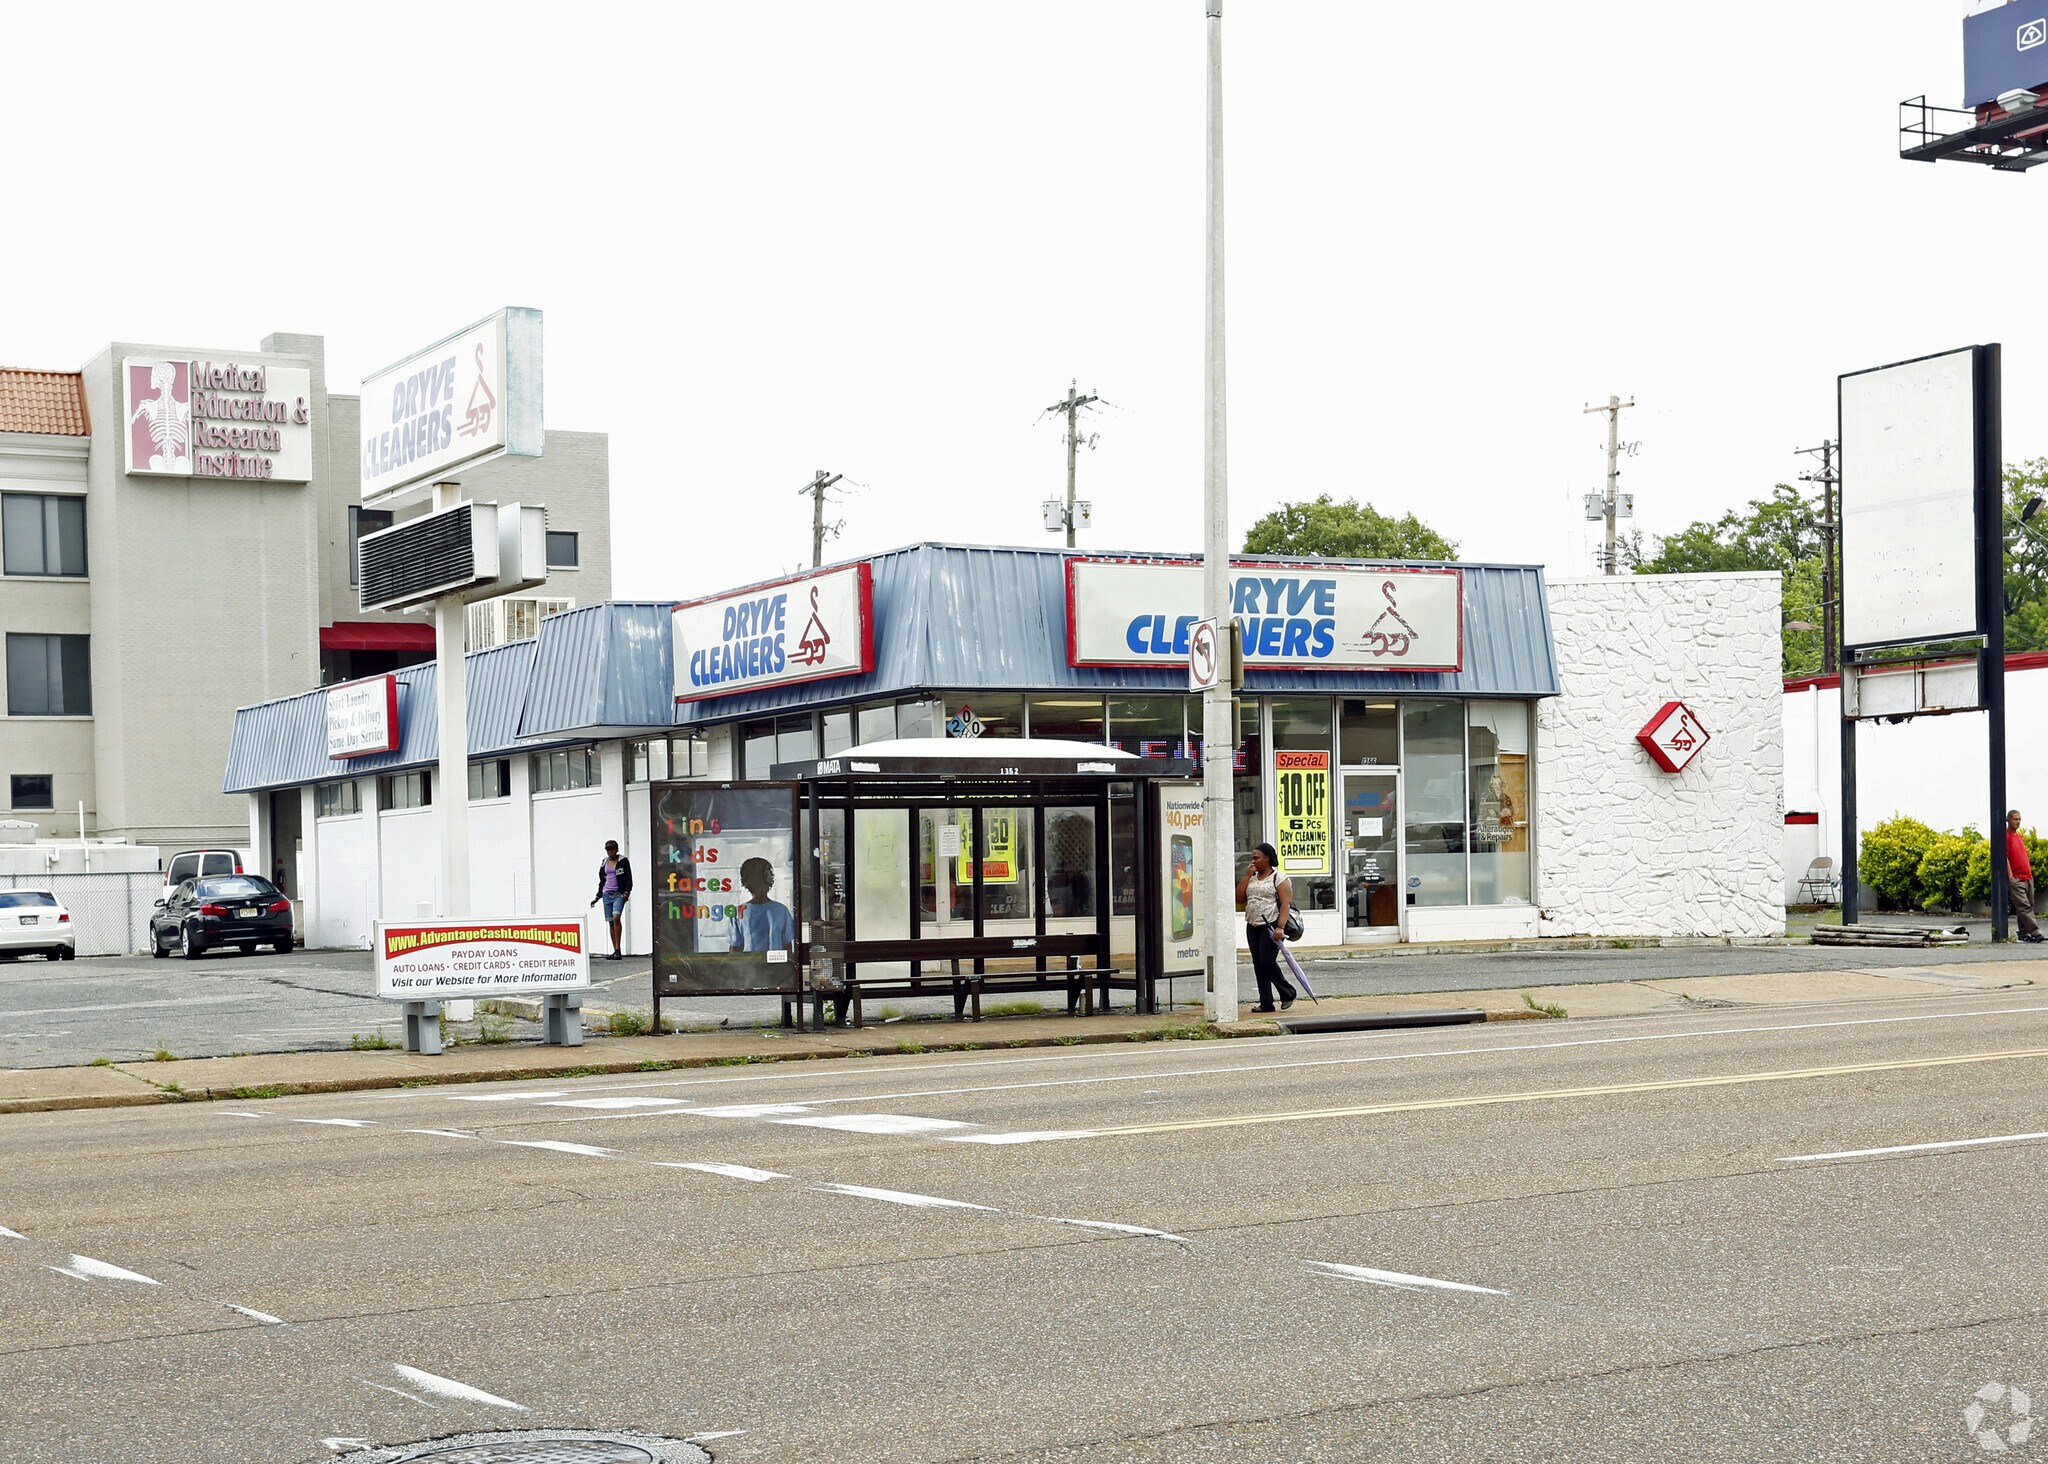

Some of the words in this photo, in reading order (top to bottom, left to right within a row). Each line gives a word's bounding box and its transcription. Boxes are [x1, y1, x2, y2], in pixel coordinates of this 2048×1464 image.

[192, 360, 267, 393] Medical
[392, 355, 457, 424] DRYVE
[192, 389, 288, 423] Education
[292, 396, 309, 424] &
[192, 418, 282, 451] Research
[363, 403, 453, 481] CLEANERS
[193, 449, 273, 479] Institute
[1228, 577, 1337, 616] RYVE
[722, 593, 787, 642] DRYVE
[1126, 614, 1336, 658] CLENERS
[690, 632, 785, 687] CLEANERS
[328, 697, 344, 712] Shirt
[346, 690, 370, 706] Laundry
[329, 715, 348, 732] Pickup
[358, 709, 381, 725] Delivery
[952, 719, 960, 733] 2
[963, 710, 971, 723] 0
[972, 721, 980, 735] 0
[329, 735, 345, 750] Same
[347, 732, 358, 748] Day
[361, 727, 384, 743] Service
[823, 759, 841, 775] MATA
[1279, 754, 1324, 767] Special
[1000, 767, 1019, 775] 1352
[1278, 773, 1303, 816] $10
[1306, 773, 1325, 816] OFF
[1166, 801, 1200, 811] Nationwide
[665, 817, 674, 835] 1
[682, 816, 704, 835] in
[710, 818, 721, 834] 5
[1289, 819, 1304, 830] 6
[1280, 829, 1293, 842] DRY
[1295, 831, 1326, 842] CLEANING
[1487, 833, 1513, 842] Repairs
[668, 845, 719, 864] kids
[1280, 844, 1326, 856] GARMENTS
[667, 872, 732, 892] faces
[668, 901, 748, 922] hunger
[451, 950, 486, 959] PAYDAY
[488, 948, 518, 958] LOANS
[393, 964, 416, 973] AUTO
[417, 963, 445, 972] LOANS
[453, 962, 481, 971] CREDIT
[483, 961, 511, 970] CARDS
[518, 960, 546, 969] CREDIT
[548, 959, 576, 968] REPAIR
[391, 977, 414, 988] Visit
[415, 978, 433, 987] our
[436, 975, 475, 986] Website
[477, 975, 492, 985] for
[494, 973, 519, 984] More
[521, 971, 577, 983] Information
